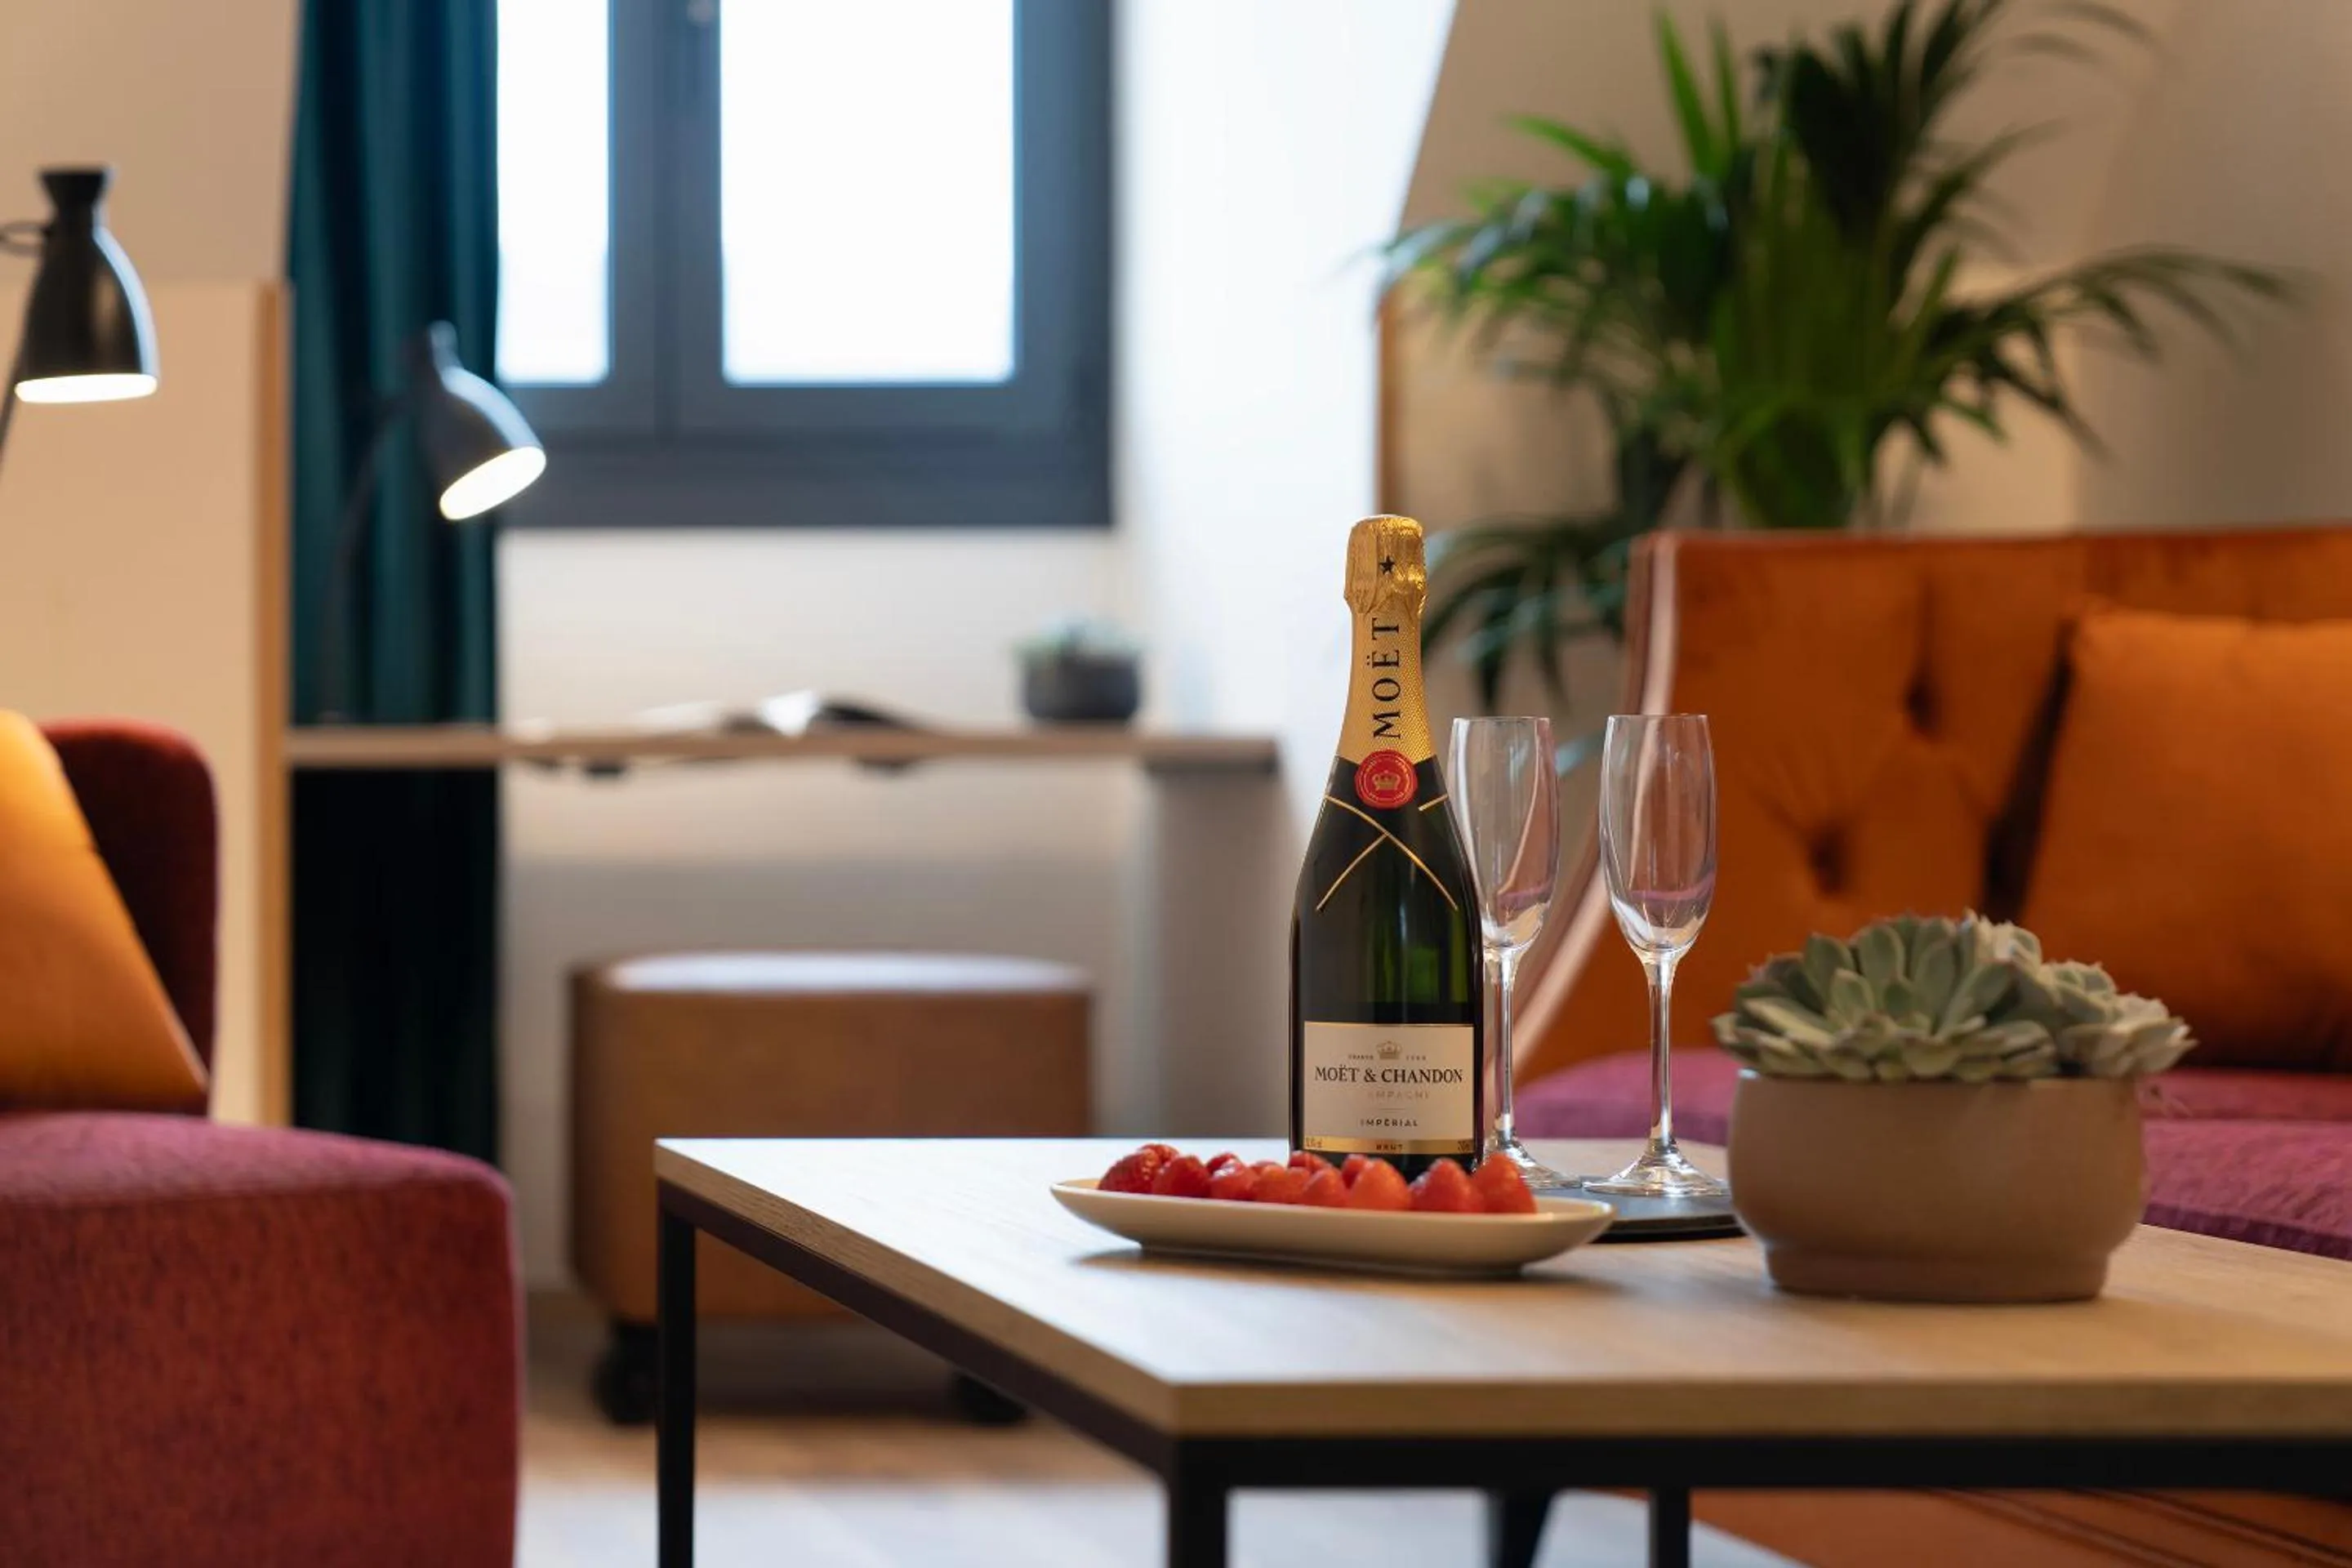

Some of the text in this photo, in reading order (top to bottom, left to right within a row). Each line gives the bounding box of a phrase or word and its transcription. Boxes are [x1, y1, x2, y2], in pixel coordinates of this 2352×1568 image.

[1366, 617, 1401, 739] MOËT
[1315, 1064, 1463, 1084] MOËT & CHANDON
